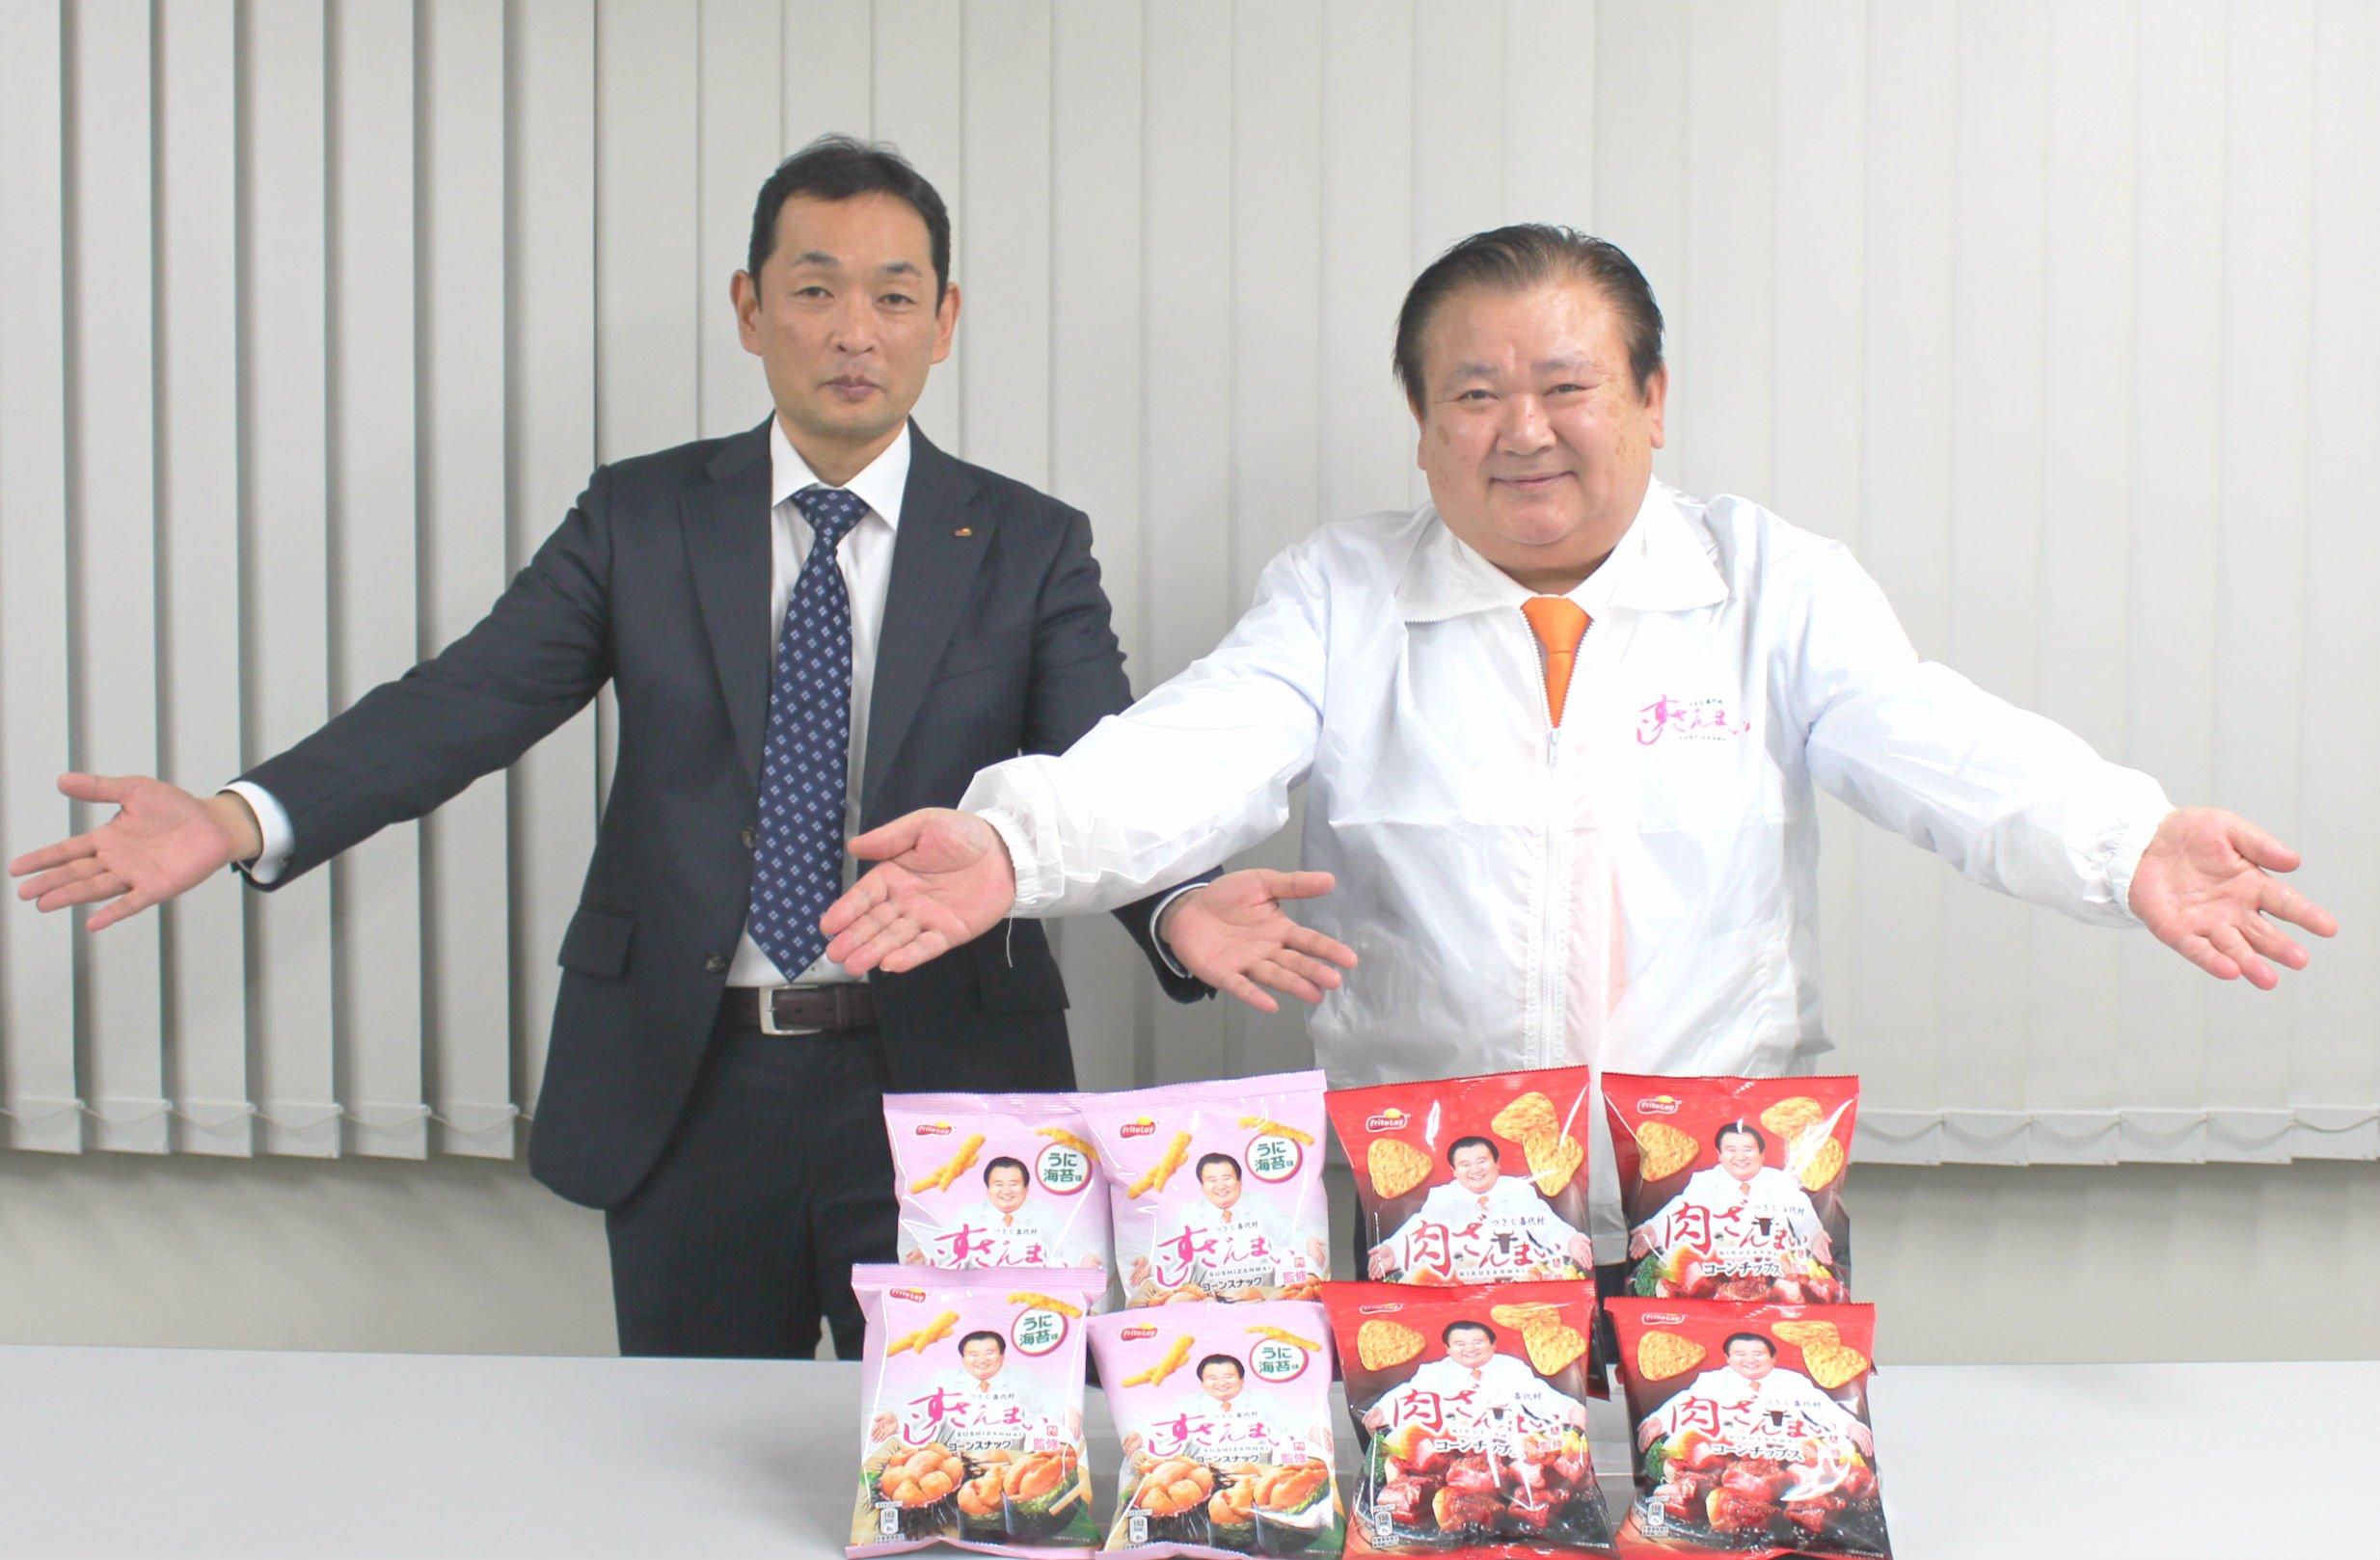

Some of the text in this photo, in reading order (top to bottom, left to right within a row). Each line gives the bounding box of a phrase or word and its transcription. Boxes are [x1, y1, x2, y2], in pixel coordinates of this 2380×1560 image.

[1258, 1142, 1286, 1156] うに
[1048, 1153, 1077, 1167] うに
[1664, 1199, 1807, 1255] 肉ざんまい
[1404, 1214, 1560, 1277] 肉ざんまい
[1704, 1262, 1782, 1276] コーンチップス
[1283, 1271, 1307, 1283] 監修
[1203, 1277, 1262, 1292] コーンスナック
[1023, 1315, 1052, 1331] うに
[1262, 1347, 1292, 1359] うに
[1671, 1395, 1836, 1438] 肉ざんまい
[949, 1440, 1011, 1452] コーンスナック
[1033, 1438, 1059, 1451] 監修
[1196, 1455, 1258, 1464] コーンスナック
[1281, 1453, 1306, 1464] 監修
[1713, 1446, 1803, 1461] コーンチップス
